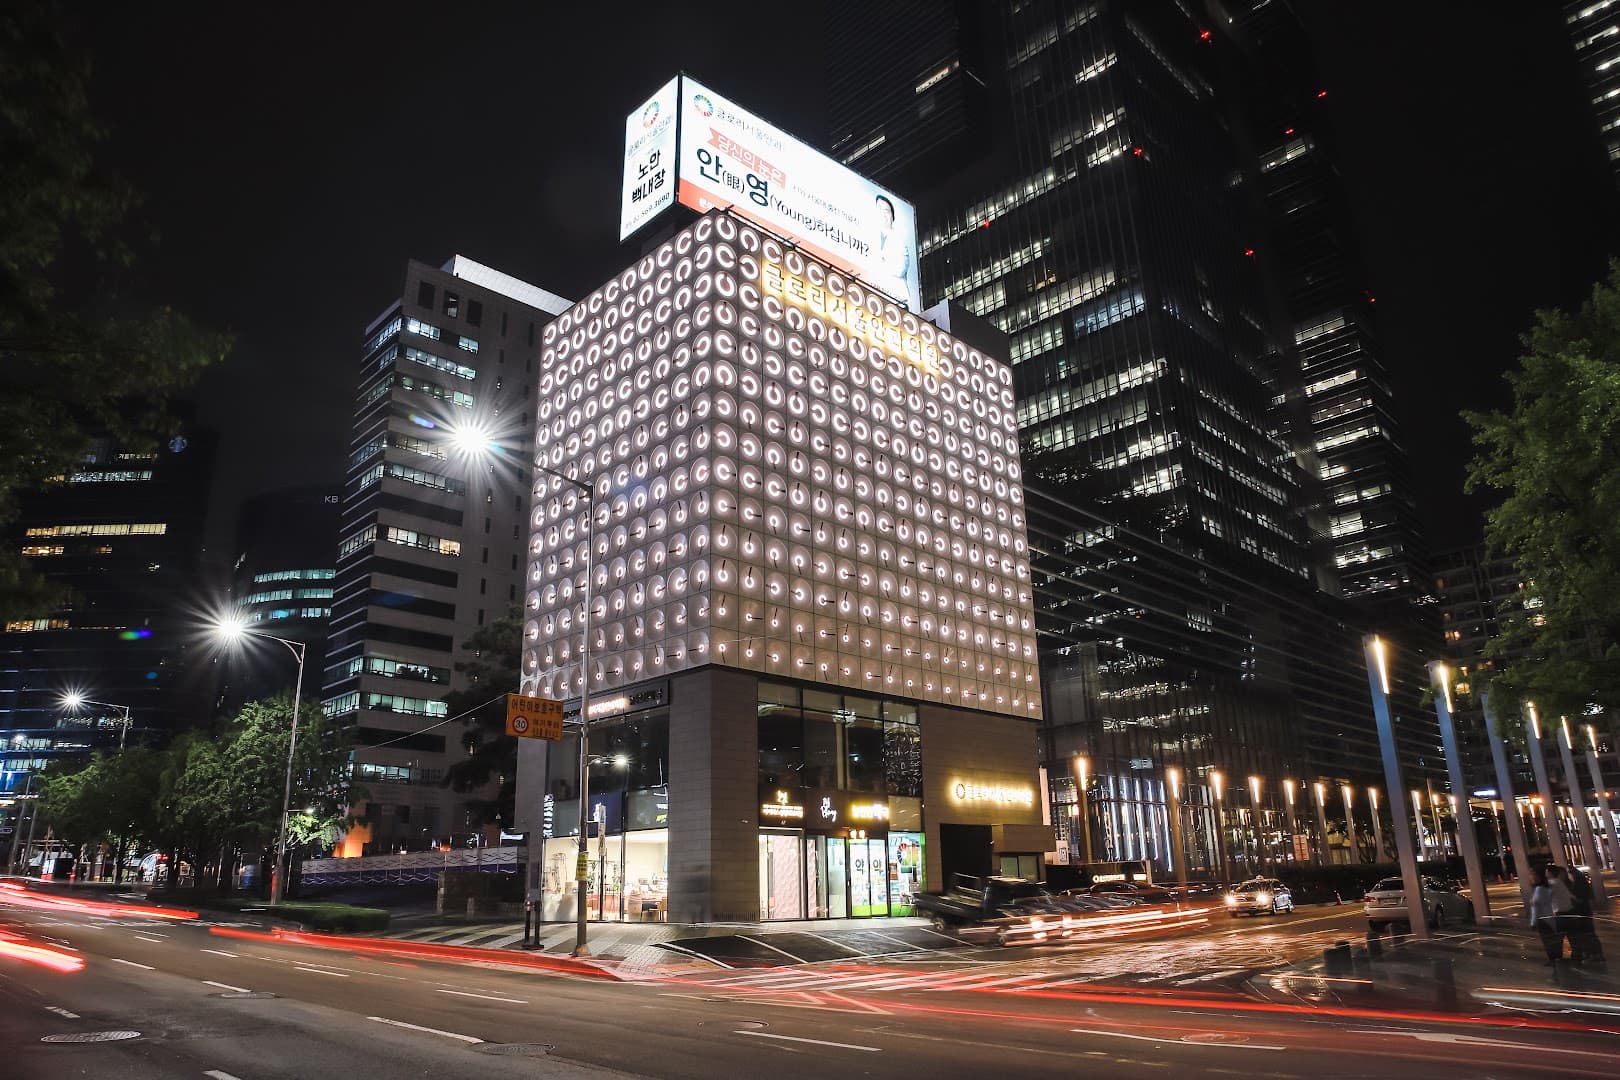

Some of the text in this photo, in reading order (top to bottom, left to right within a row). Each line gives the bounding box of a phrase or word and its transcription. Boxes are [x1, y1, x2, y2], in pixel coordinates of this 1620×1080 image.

[638, 149, 661, 180] 노안
[718, 133, 756, 170] 당신의
[632, 168, 666, 204] 백내장
[765, 263, 941, 372] 글로리서울안과의원
[324, 495, 339, 504] KB
[511, 698, 562, 716] 어린이보호구역
[515, 719, 526, 729] 30
